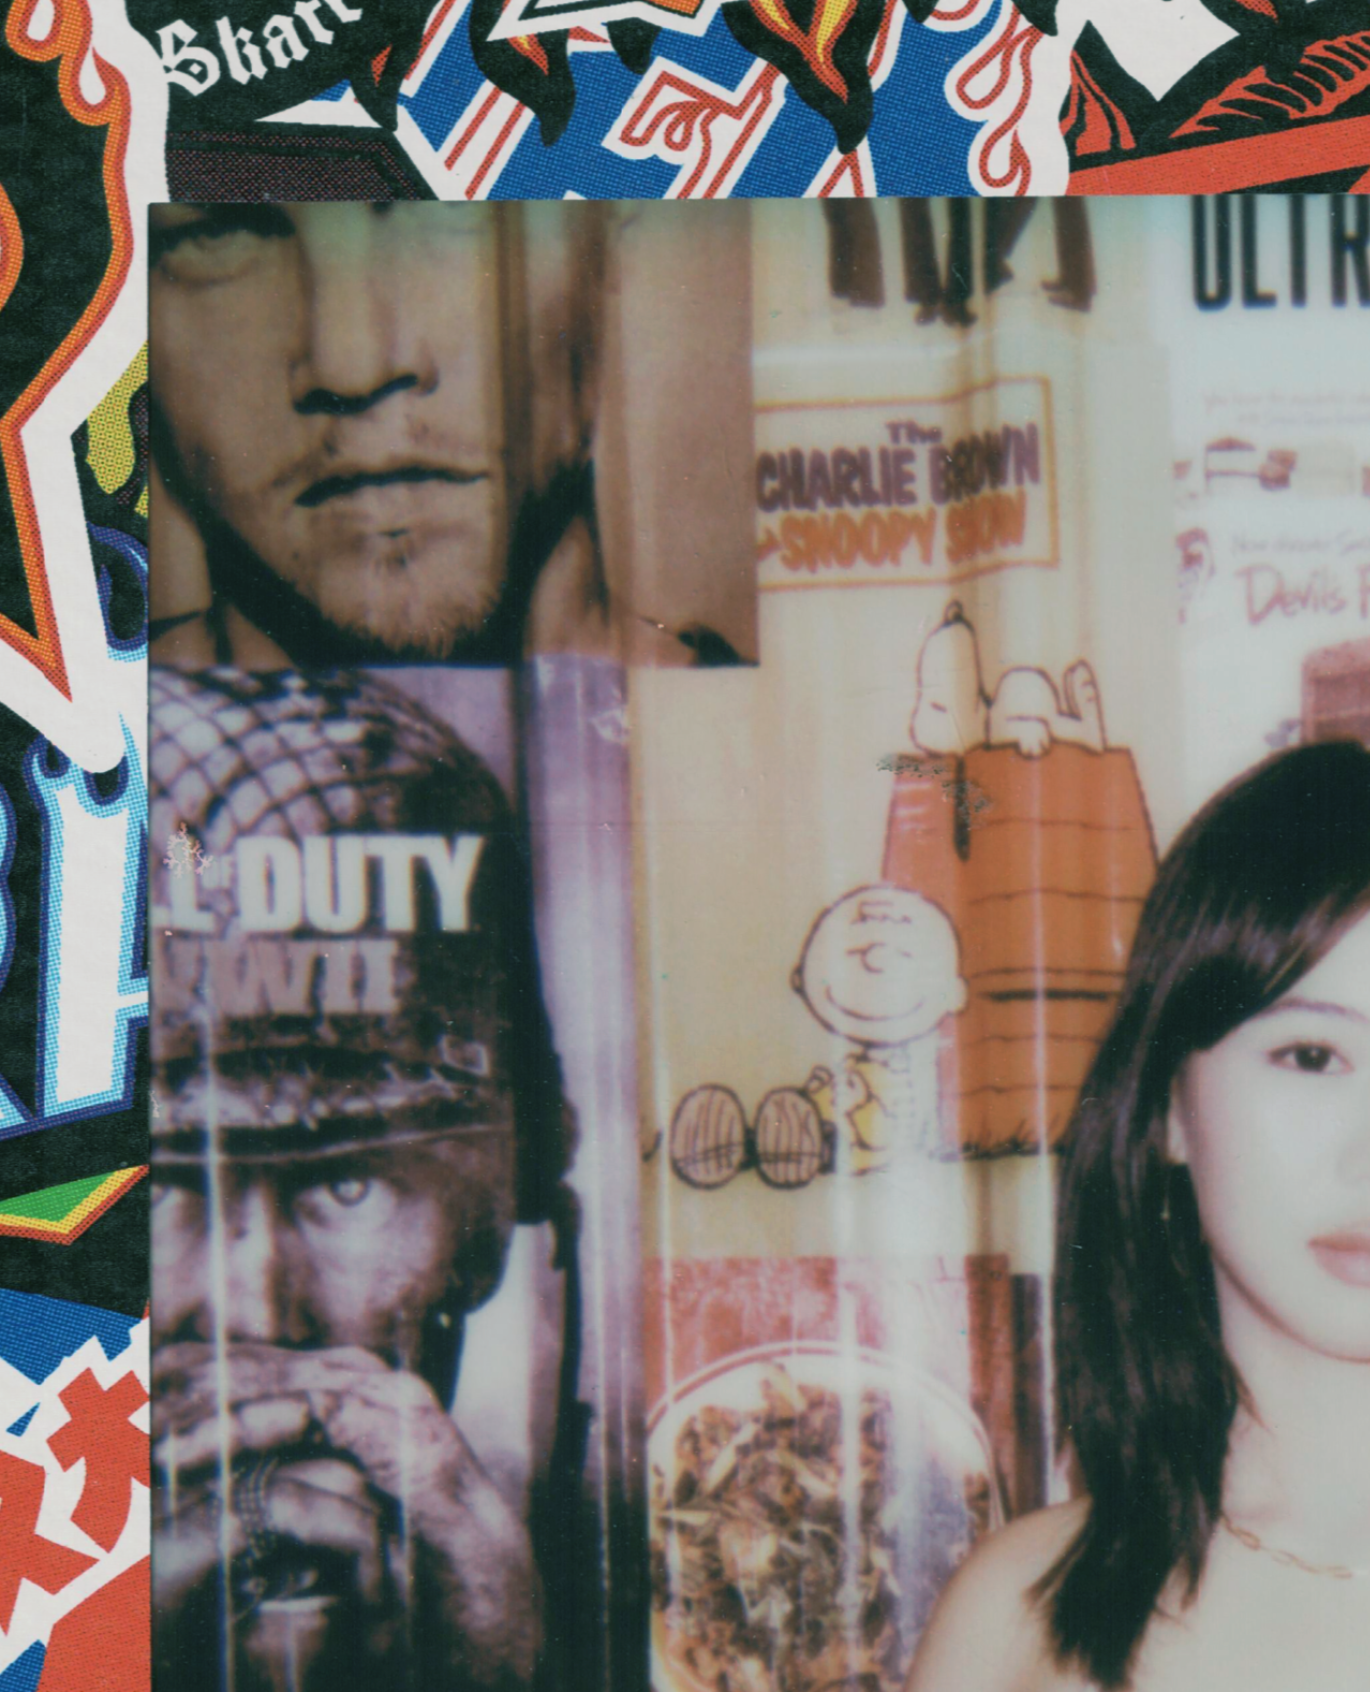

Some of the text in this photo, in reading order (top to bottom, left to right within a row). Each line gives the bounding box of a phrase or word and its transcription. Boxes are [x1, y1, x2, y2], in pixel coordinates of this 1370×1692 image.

[756, 444, 917, 513] CHARLIE
[780, 507, 937, 574] SNOOPY
[236, 834, 486, 934] DUTY
